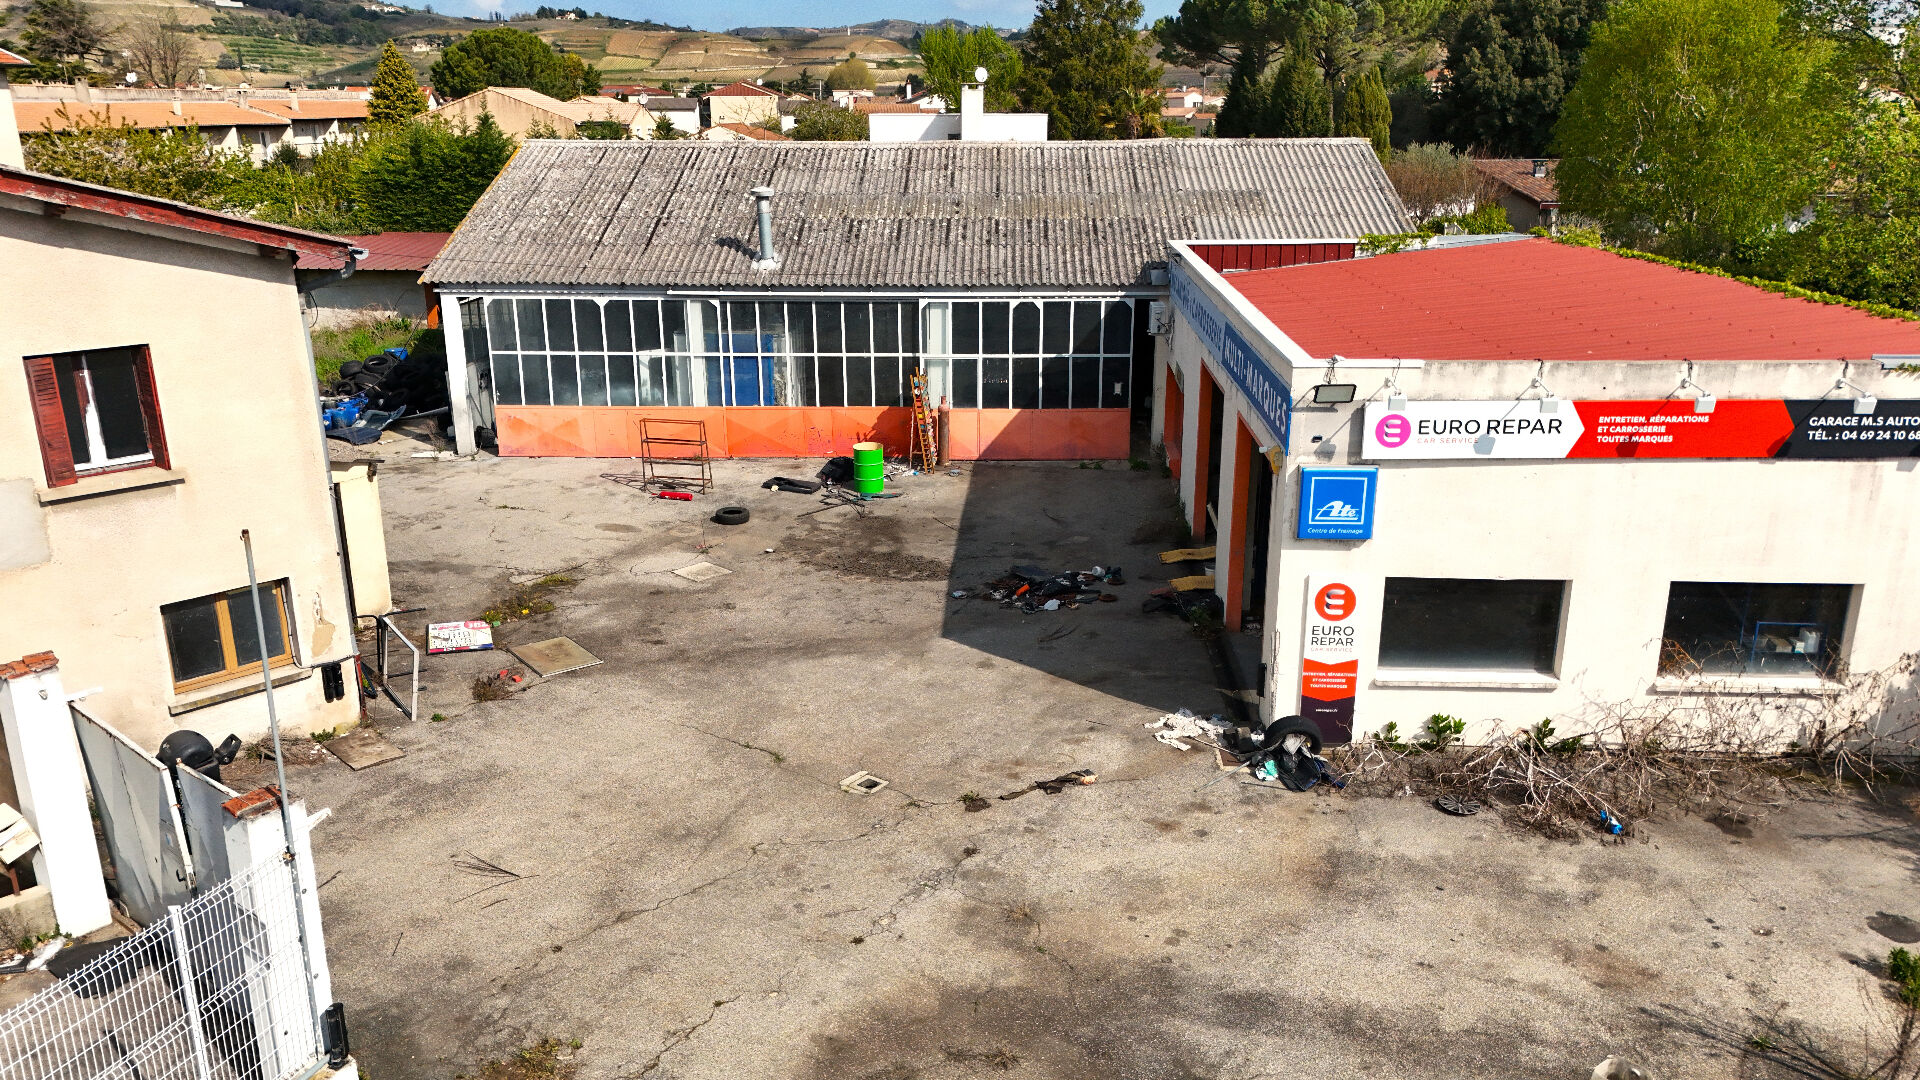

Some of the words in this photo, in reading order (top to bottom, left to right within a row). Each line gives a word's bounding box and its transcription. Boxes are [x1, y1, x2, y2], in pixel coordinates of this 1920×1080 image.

[1224, 335, 1287, 435] MULTI-MARQUES
[1598, 416, 1648, 424] ENTRETIEN,
[1649, 414, 1710, 423] RÉPARATIONS
[1809, 416, 1859, 426] GARAGE
[1860, 416, 1884, 426] M.S
[1418, 419, 1481, 435] EURO
[1486, 419, 1563, 435] REPAR
[1597, 425, 1608, 433] ET
[1609, 425, 1667, 433] CARROSSERIE
[1596, 435, 1630, 443] TOUTES
[1630, 435, 1674, 443] MARQUES
[1807, 428, 1833, 440] TÉL.
[1841, 430, 1857, 440] 04
[1860, 430, 1875, 440] 69
[1876, 430, 1891, 440] 24
[1893, 430, 1906, 440] 10
[1311, 625, 1355, 636] EURO
[1310, 636, 1354, 647] REPAR
